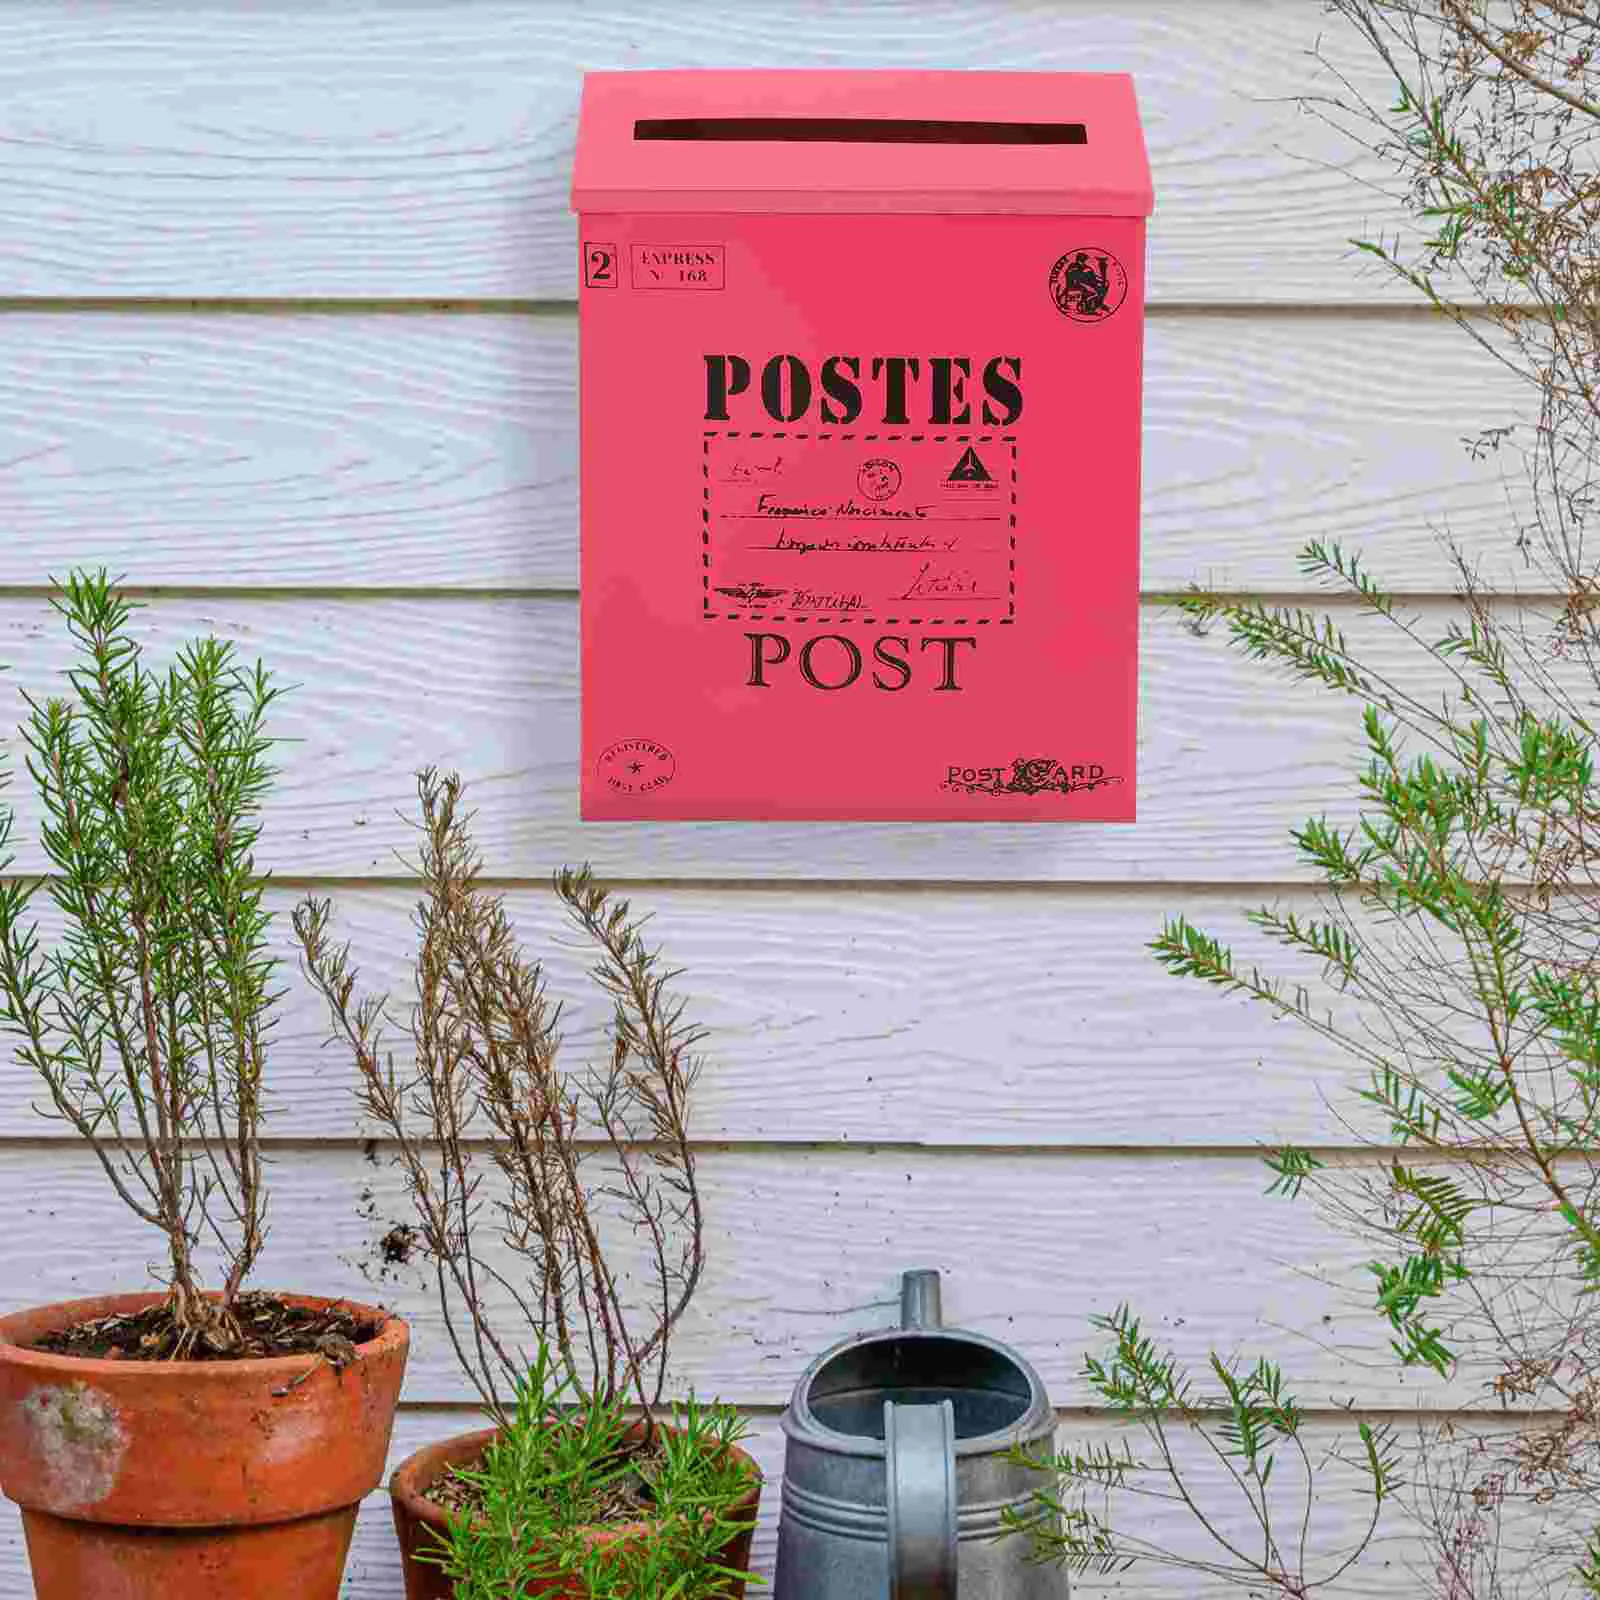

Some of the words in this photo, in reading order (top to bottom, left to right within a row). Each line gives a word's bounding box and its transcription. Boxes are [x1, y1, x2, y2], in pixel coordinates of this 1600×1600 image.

[591, 251, 610, 279] 2
[640, 251, 715, 265] EXPRESS
[703, 354, 1023, 426] POSTES
[743, 632, 977, 691] POST
[948, 766, 1006, 783] POST
